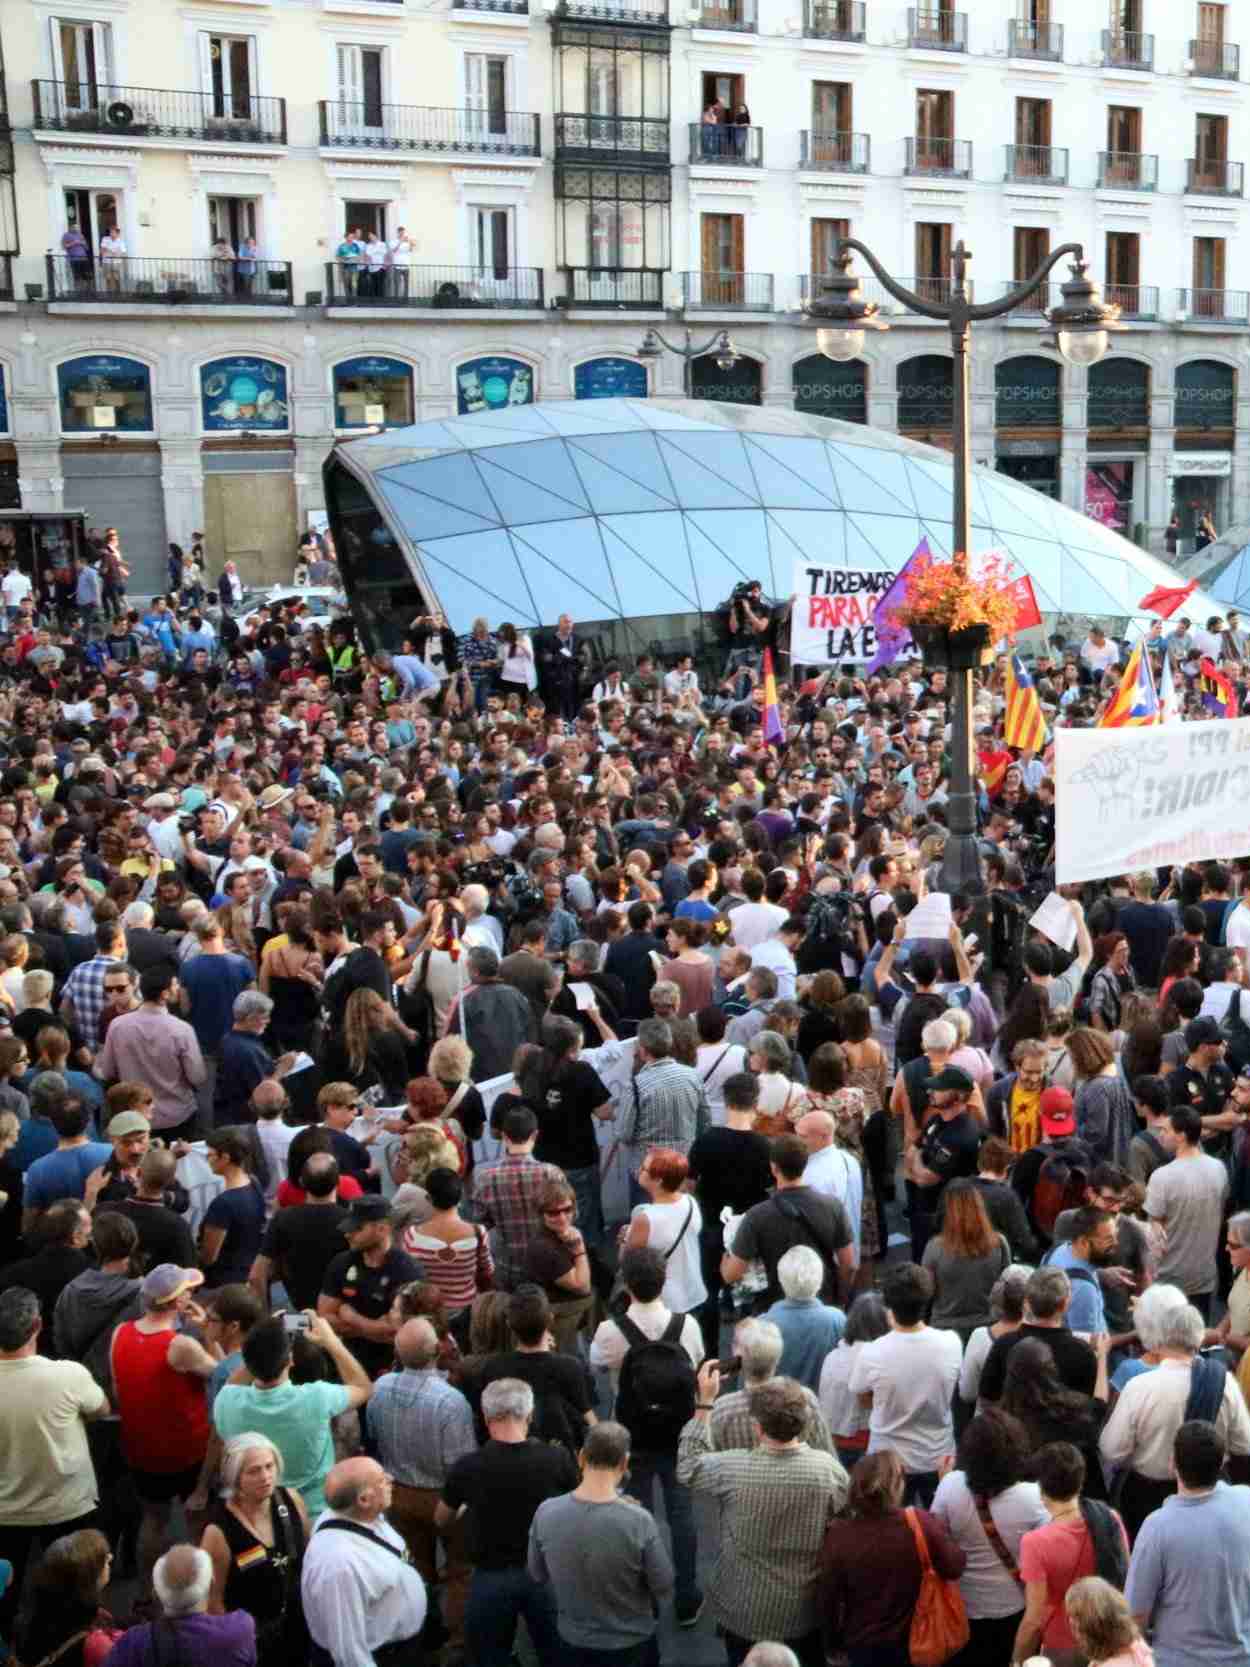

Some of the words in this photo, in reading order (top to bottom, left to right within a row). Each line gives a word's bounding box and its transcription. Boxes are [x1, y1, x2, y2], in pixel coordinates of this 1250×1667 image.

[690, 384, 758, 400] OPSHOP
[897, 385, 955, 400] TOPSHO
[808, 595, 865, 628] PARA
[827, 628, 857, 660] LA
